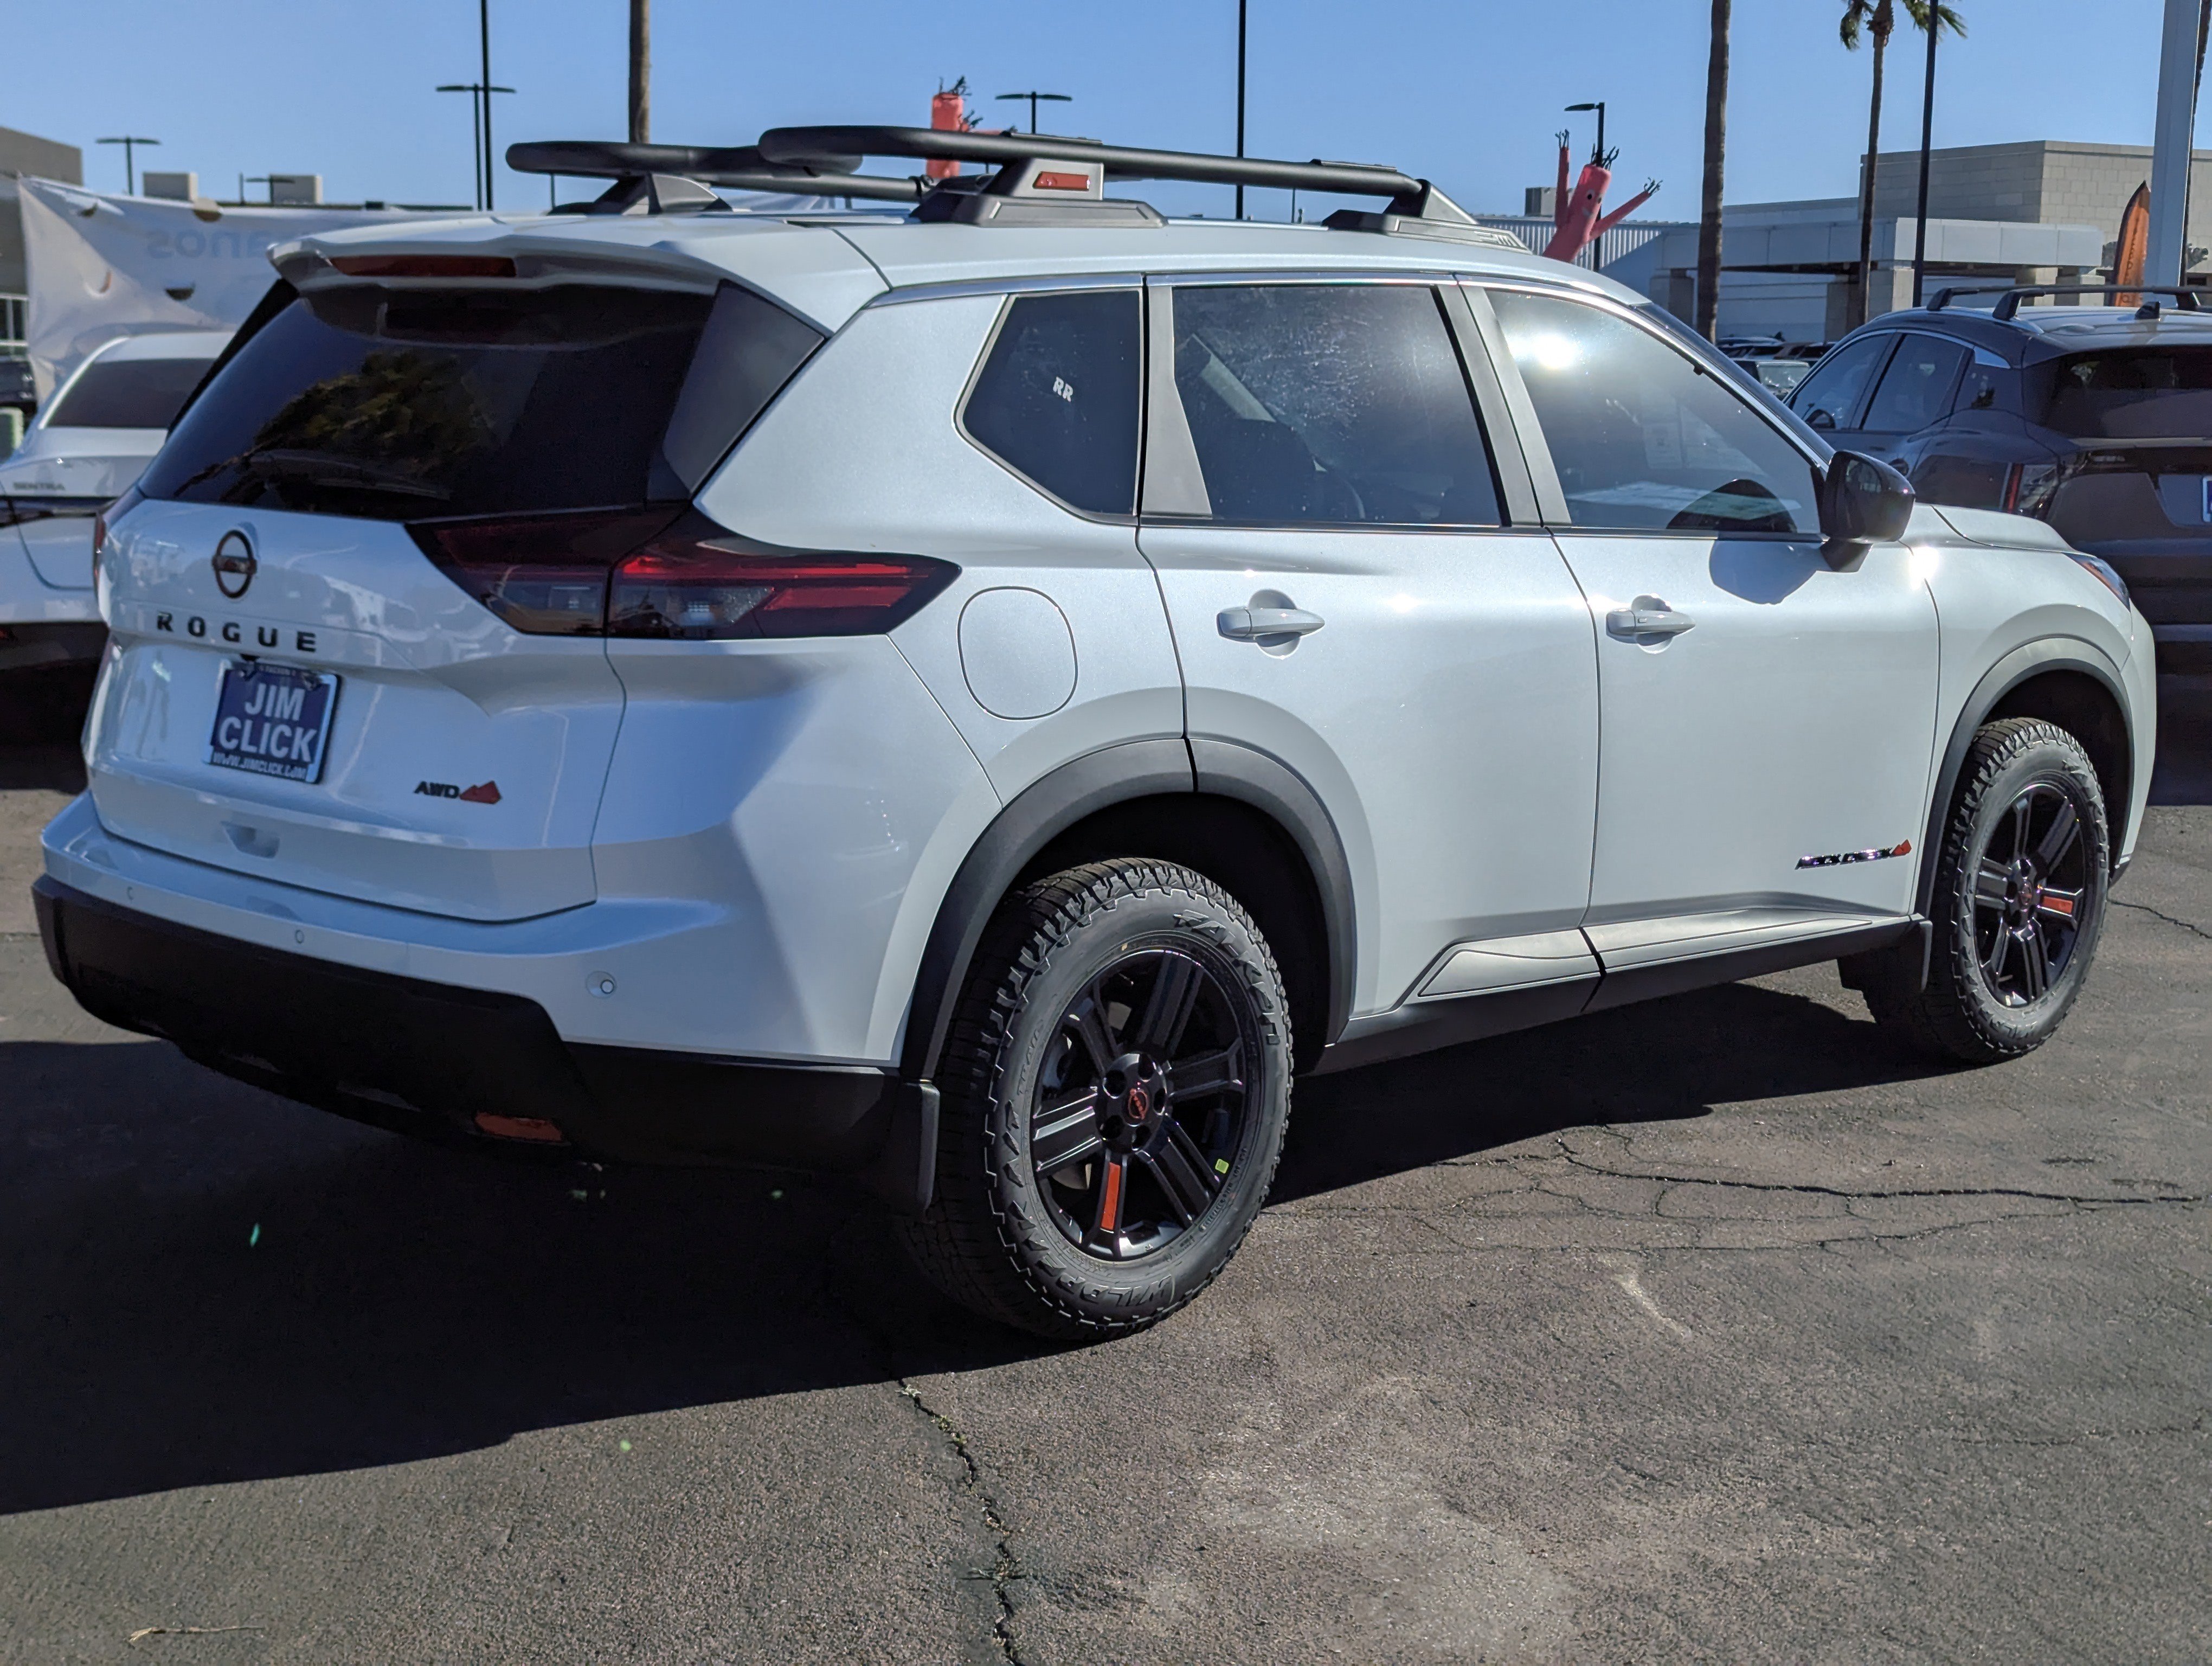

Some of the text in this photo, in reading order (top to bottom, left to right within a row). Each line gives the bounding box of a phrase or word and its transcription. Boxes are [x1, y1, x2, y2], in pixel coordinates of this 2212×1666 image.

[1053, 376, 1073, 402] RR
[156, 611, 317, 652] ROGUE
[245, 682, 306, 721] JIM
[219, 716, 317, 762] CLICK
[414, 781, 460, 799] AWD
[1173, 909, 1281, 1046] FALKEN
